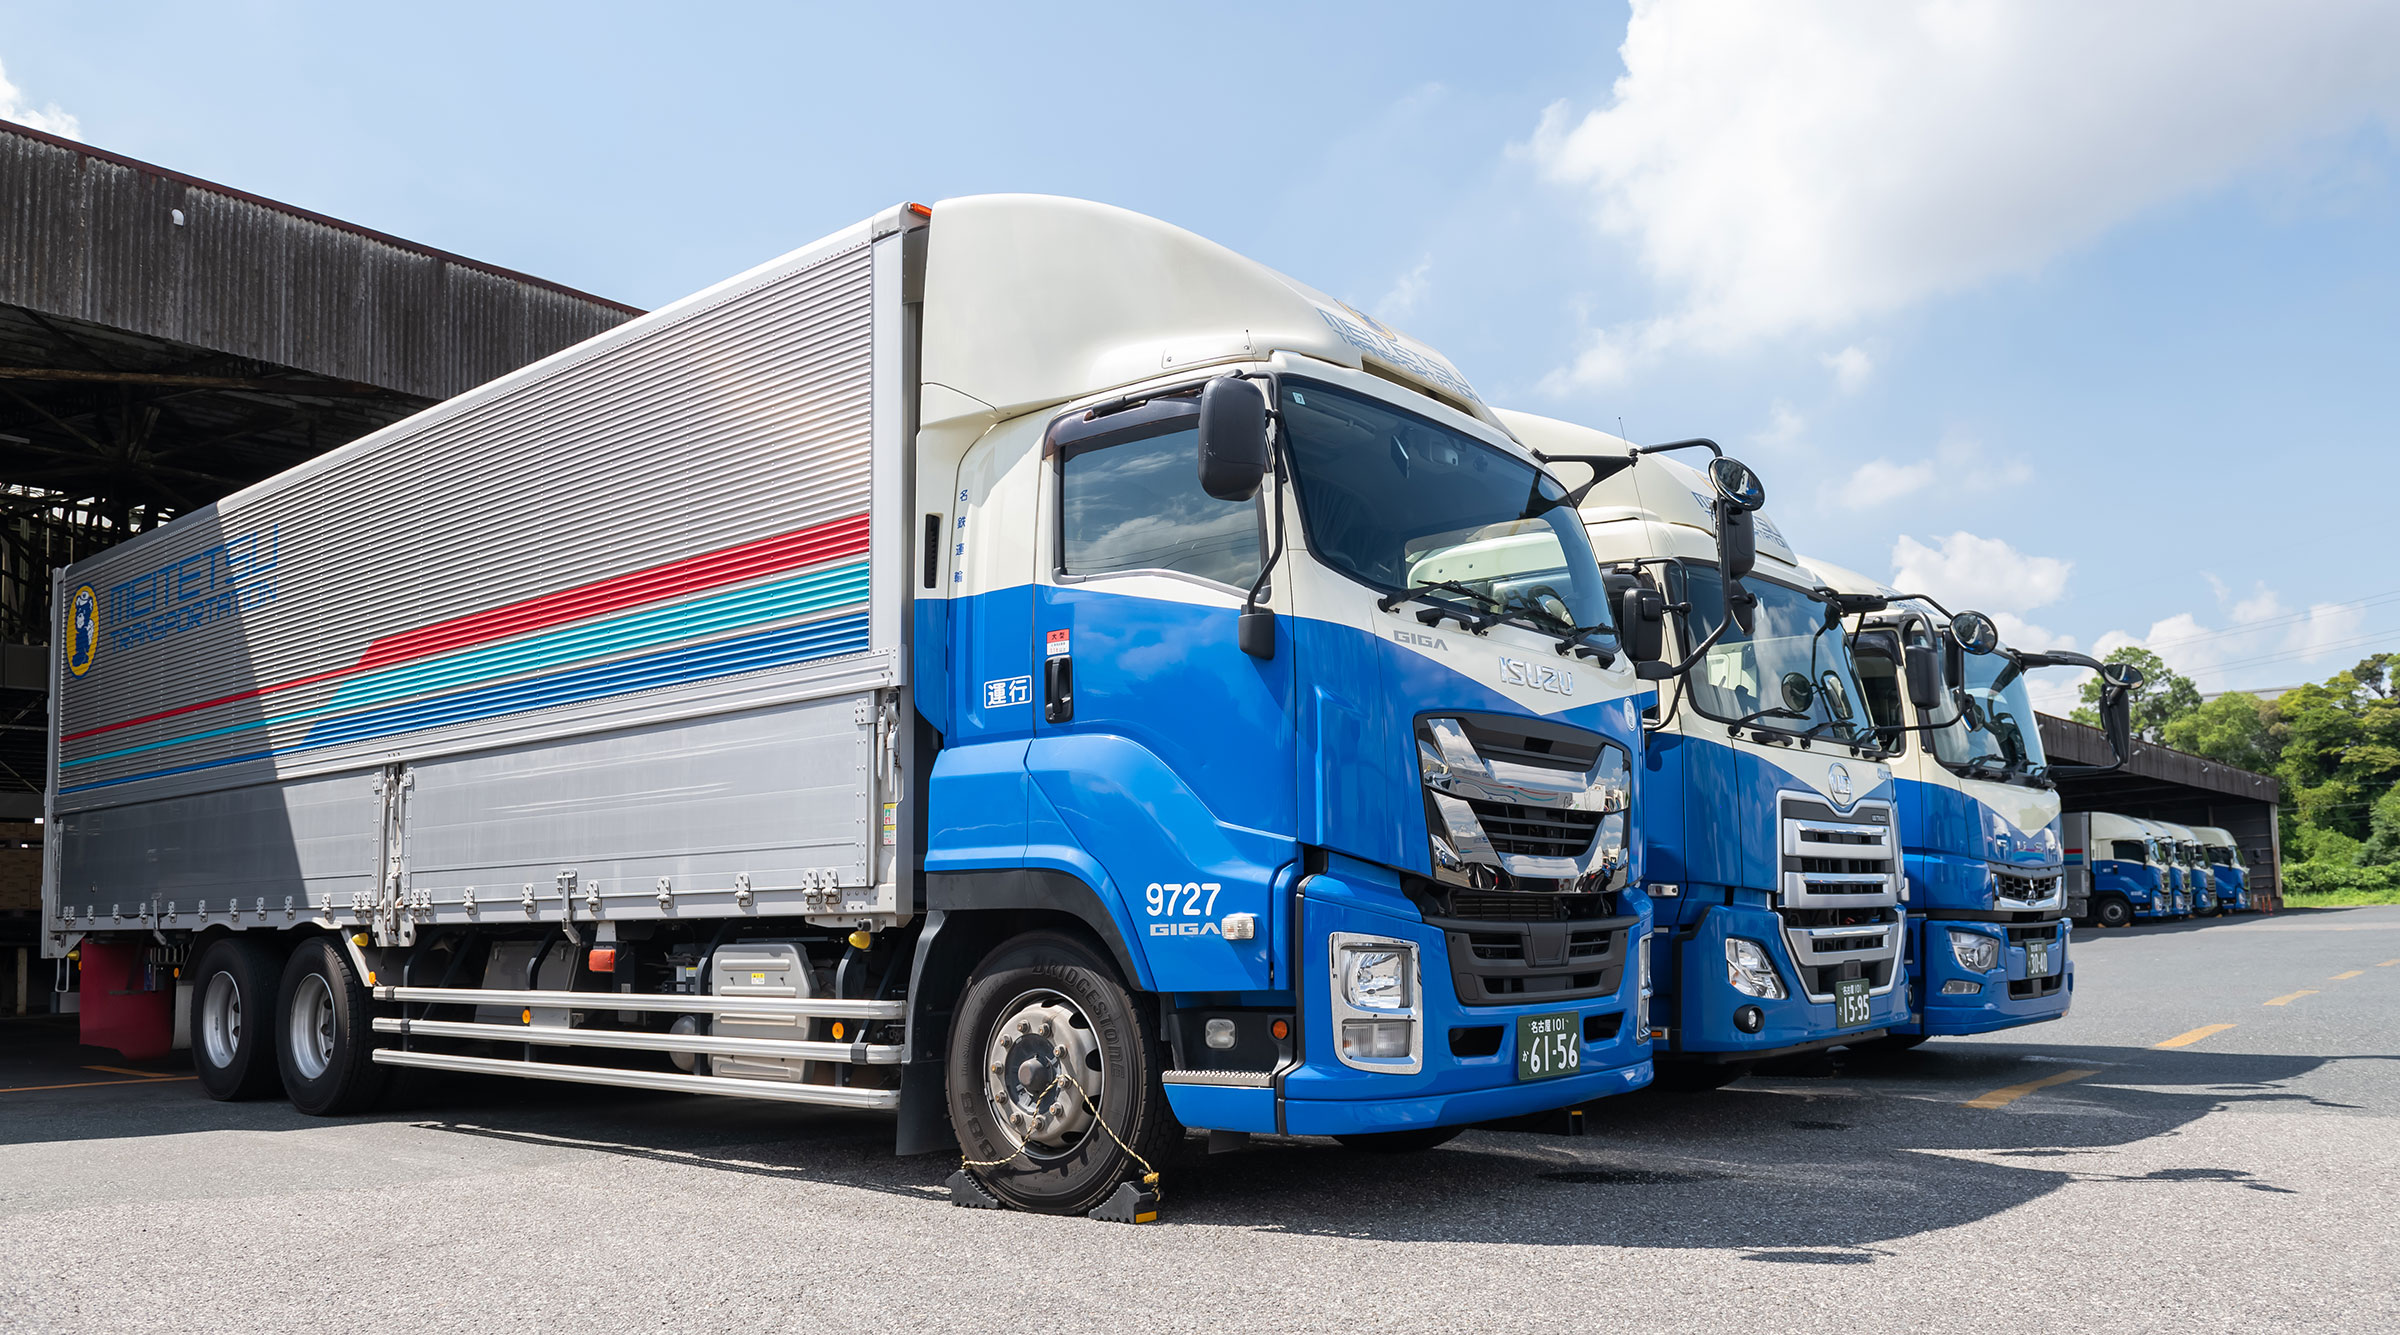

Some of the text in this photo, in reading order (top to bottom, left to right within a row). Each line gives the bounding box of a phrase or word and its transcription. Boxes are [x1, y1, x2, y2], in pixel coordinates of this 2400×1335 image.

[1316, 307, 1472, 391] MEITETSU
[954, 489, 968, 583] 名鉄運輸
[110, 523, 279, 626] MEITETSU
[109, 575, 279, 652] TRANSPORTATION
[1393, 629, 1449, 652] GIGA
[988, 680, 1028, 706] 運行
[1499, 655, 1574, 696] ISUZU
[1145, 882, 1222, 917] 9727
[1149, 922, 1221, 937] GIGA
[1031, 956, 1126, 1079] BRIDGESTONE
[1530, 1018, 1565, 1034] 名古屋 101
[1522, 1032, 1578, 1073] か 61-56
